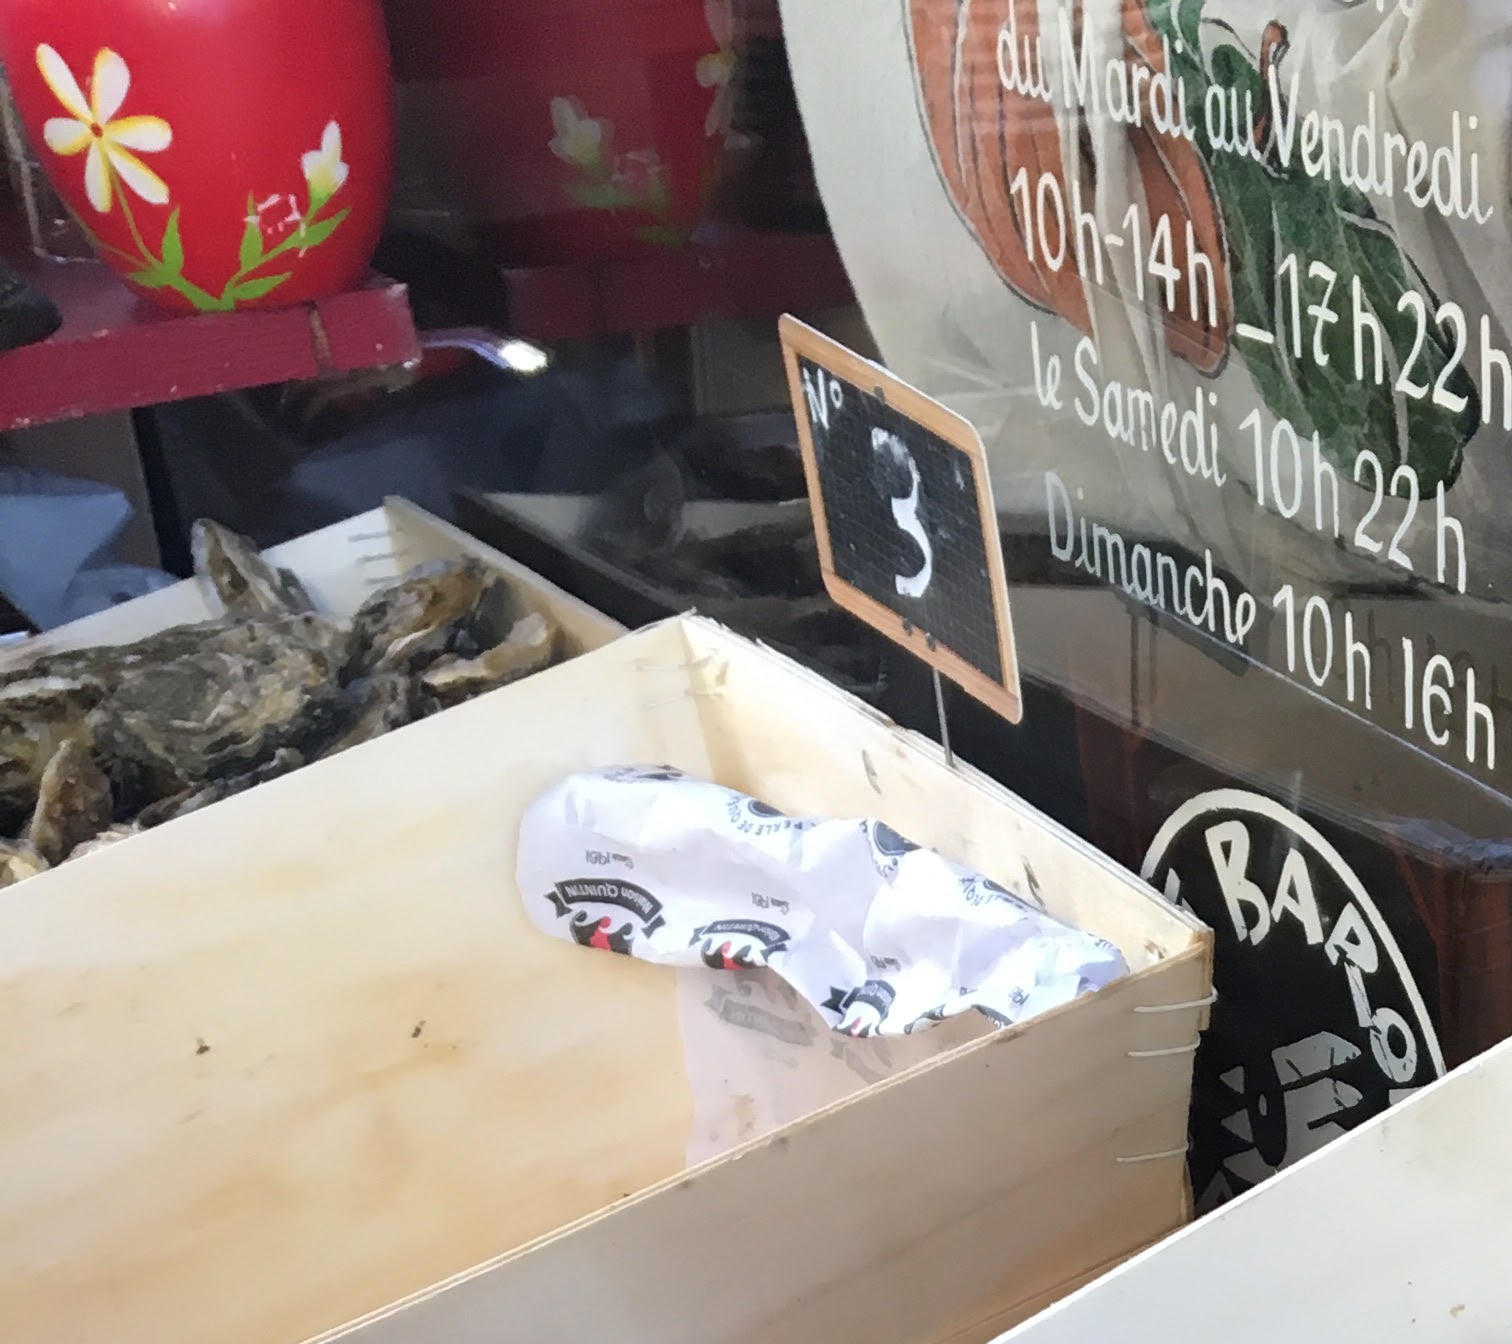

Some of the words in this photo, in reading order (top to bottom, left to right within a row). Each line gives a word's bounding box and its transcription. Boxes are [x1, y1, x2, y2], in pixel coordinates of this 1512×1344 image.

[997, 1, 1051, 101] du
[1060, 8, 1195, 142] Mardi
[1205, 83, 1262, 160] au
[1265, 65, 1494, 226] Vendredi
[1030, 321, 1063, 412] le
[1073, 335, 1226, 488] Samedi
[871, 427, 932, 599] 3
[1045, 471, 1257, 645] Dimanche
[565, 883, 619, 898] QUINTIN
[620, 886, 654, 914] Maison
